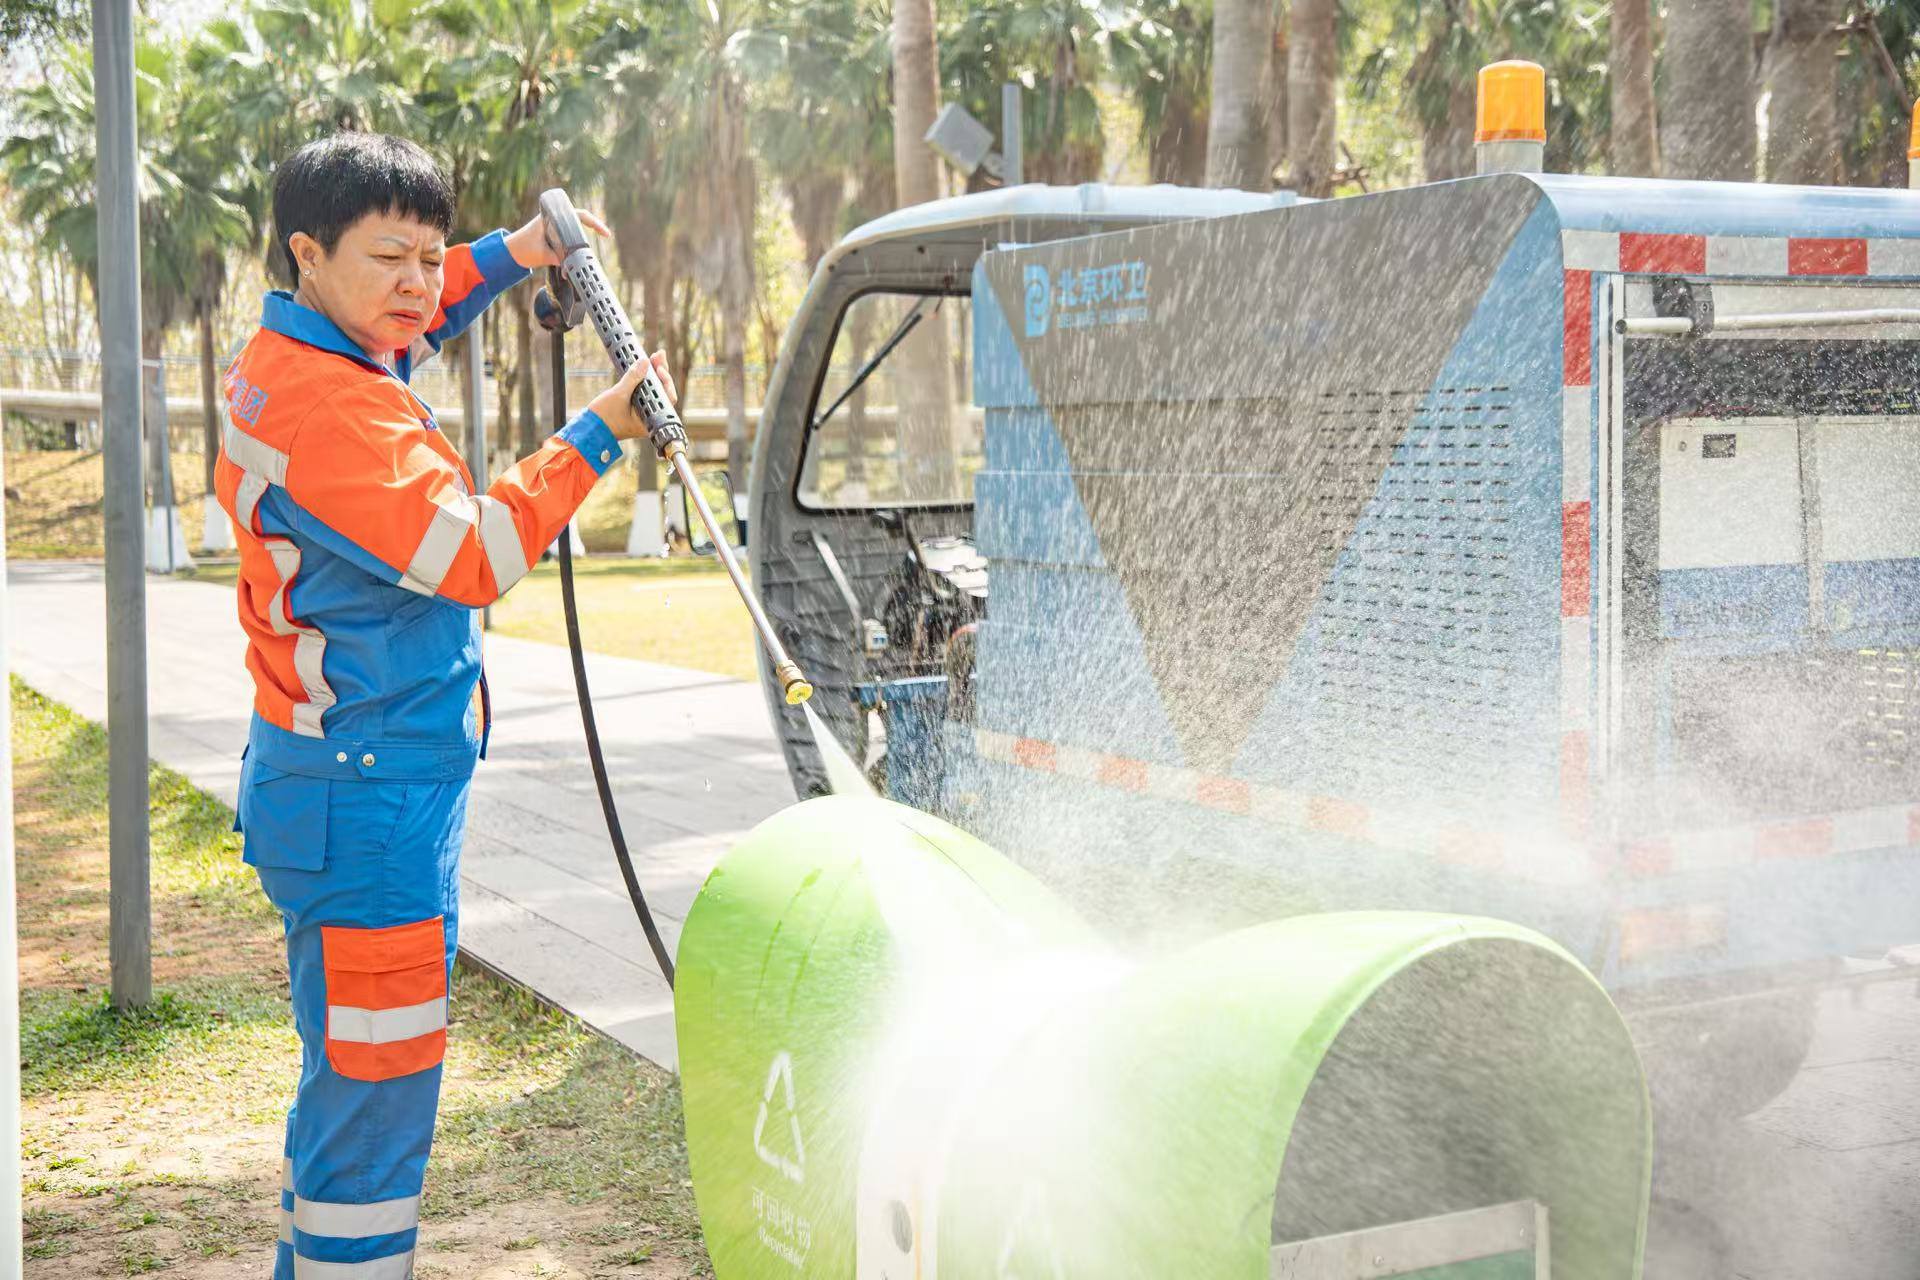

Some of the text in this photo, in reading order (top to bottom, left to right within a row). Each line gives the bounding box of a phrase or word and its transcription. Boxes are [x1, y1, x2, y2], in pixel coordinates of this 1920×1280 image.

[1057, 261, 1148, 306] 北京环卫
[751, 1185, 811, 1249] 可回收物
